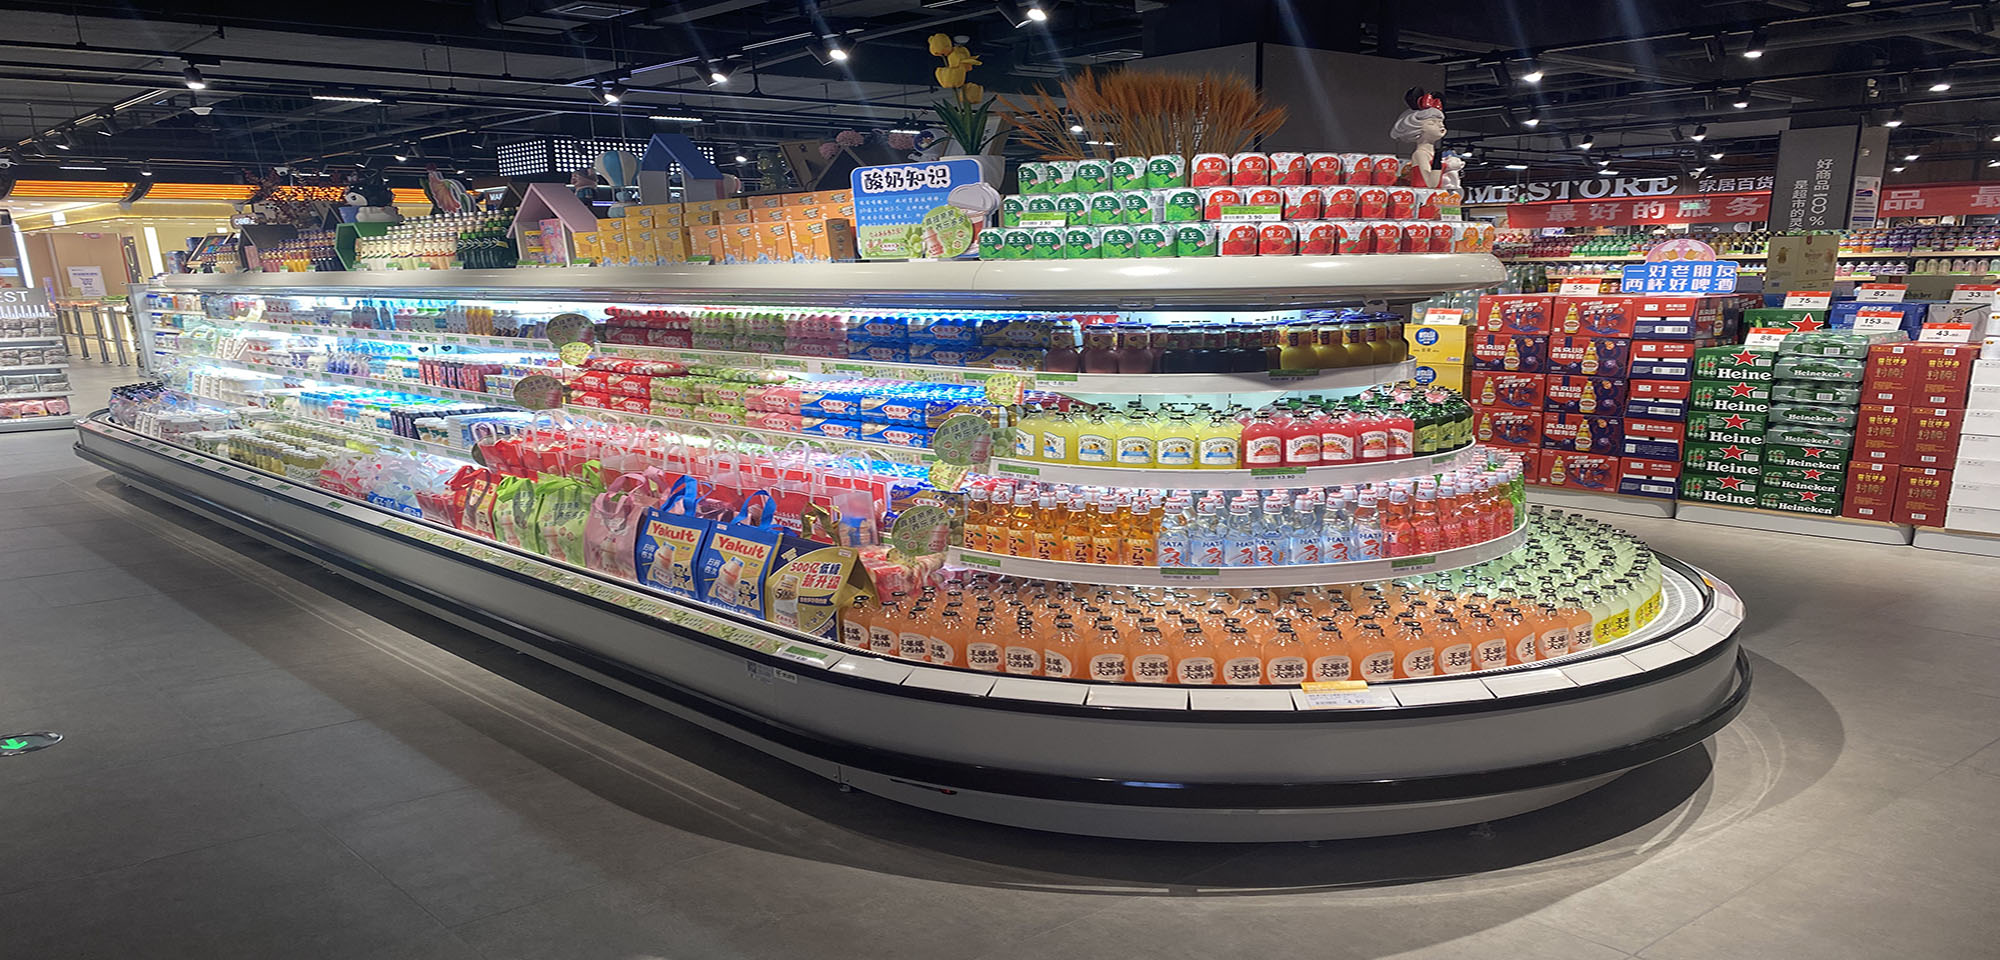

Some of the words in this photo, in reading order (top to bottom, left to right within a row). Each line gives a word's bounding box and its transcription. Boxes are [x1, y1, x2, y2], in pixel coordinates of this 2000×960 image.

[864, 168, 948, 190] 酸奶知识
[1698, 176, 1775, 193] 家居百货
[1459, 176, 1678, 206] MESTORE
[1546, 197, 1765, 223] 最好的服务
[1626, 264, 1737, 278] 一对老朋友
[1625, 278, 1735, 291] 两杯好啤酒
[1793, 368, 1841, 378] Heineken
[1788, 413, 1835, 422] Heineken
[1785, 435, 1831, 445] Heineken
[1786, 458, 1842, 470] Heineken
[1781, 480, 1837, 493] Heineken
[1778, 502, 1834, 515] Heineken
[772, 518, 802, 531] Yaku
[651, 522, 696, 543] Yakult
[717, 536, 766, 559] Yakult
[790, 560, 842, 576] 500亿低糖
[800, 572, 842, 591] 新升级
